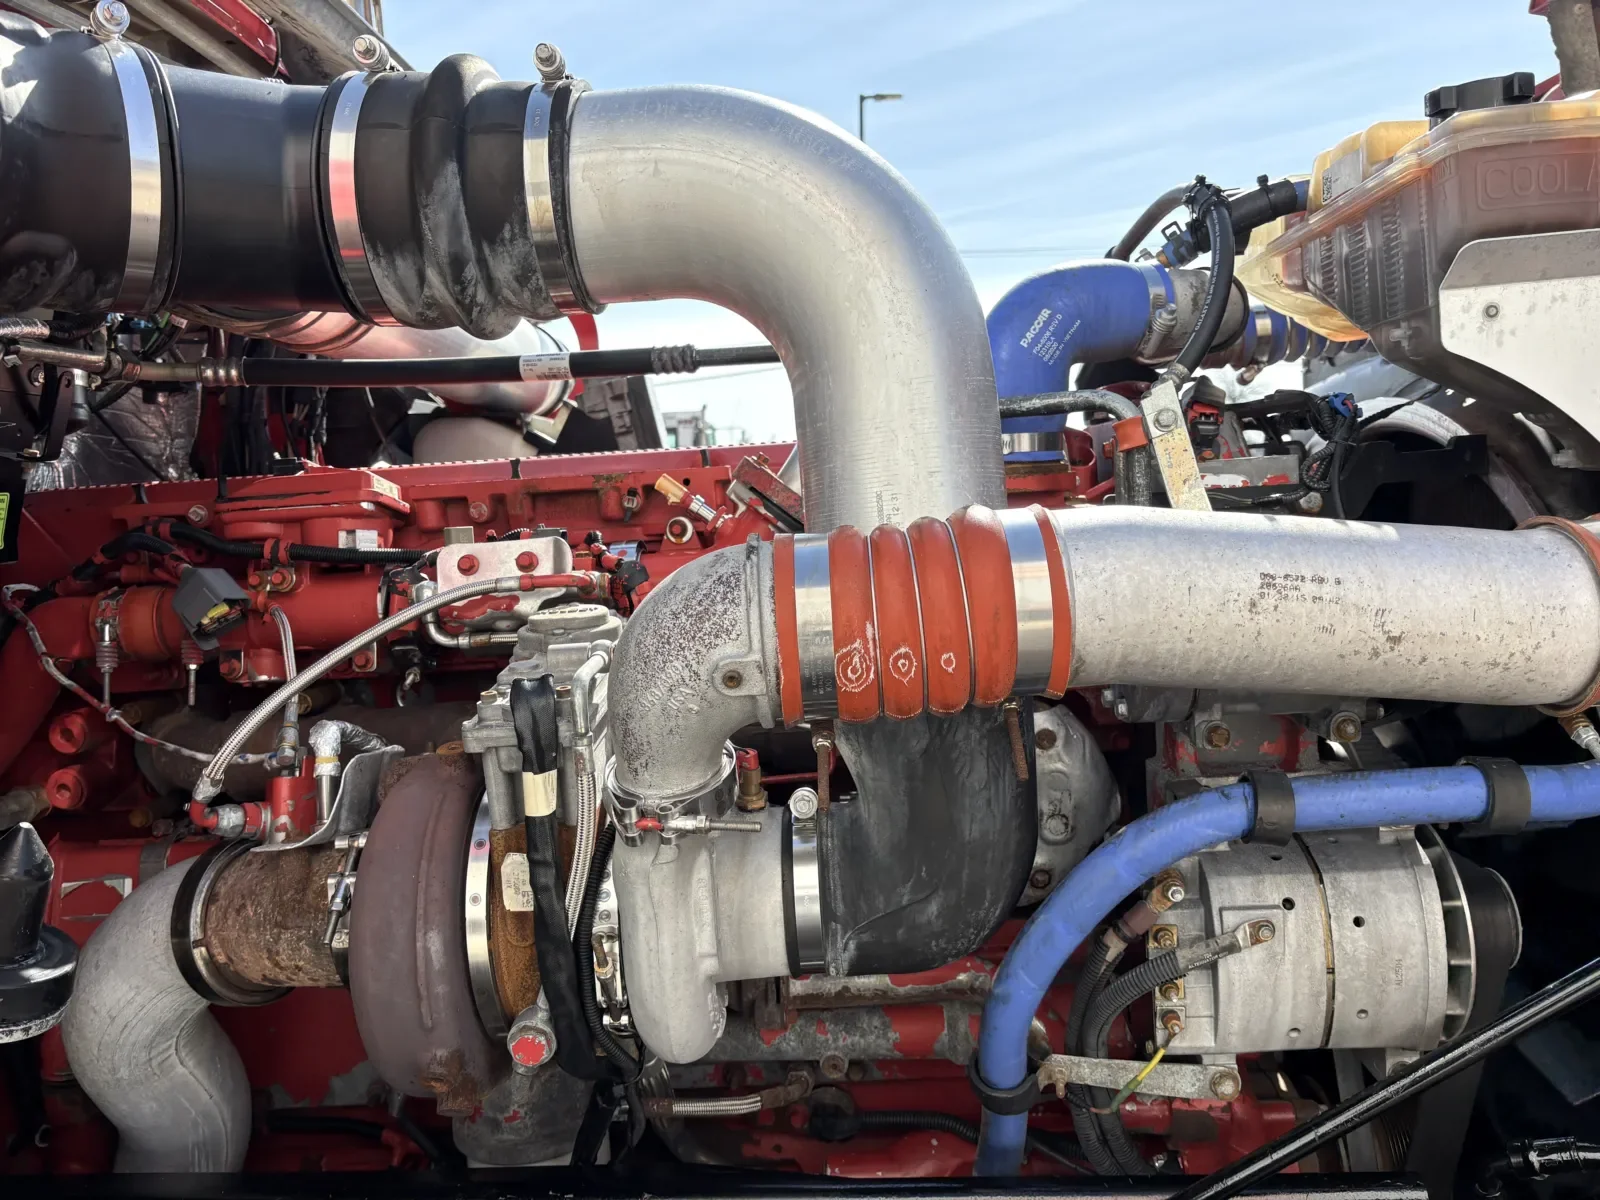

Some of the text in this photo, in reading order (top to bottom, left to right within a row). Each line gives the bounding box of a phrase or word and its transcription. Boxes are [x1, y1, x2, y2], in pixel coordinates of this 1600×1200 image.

[1019, 308, 1052, 348] PACCAR
[1194, 304, 1209, 331] GALAXY
[1062, 319, 1081, 343] VIETNAM
[1188, 954, 1219, 969] ALTERNATOR
